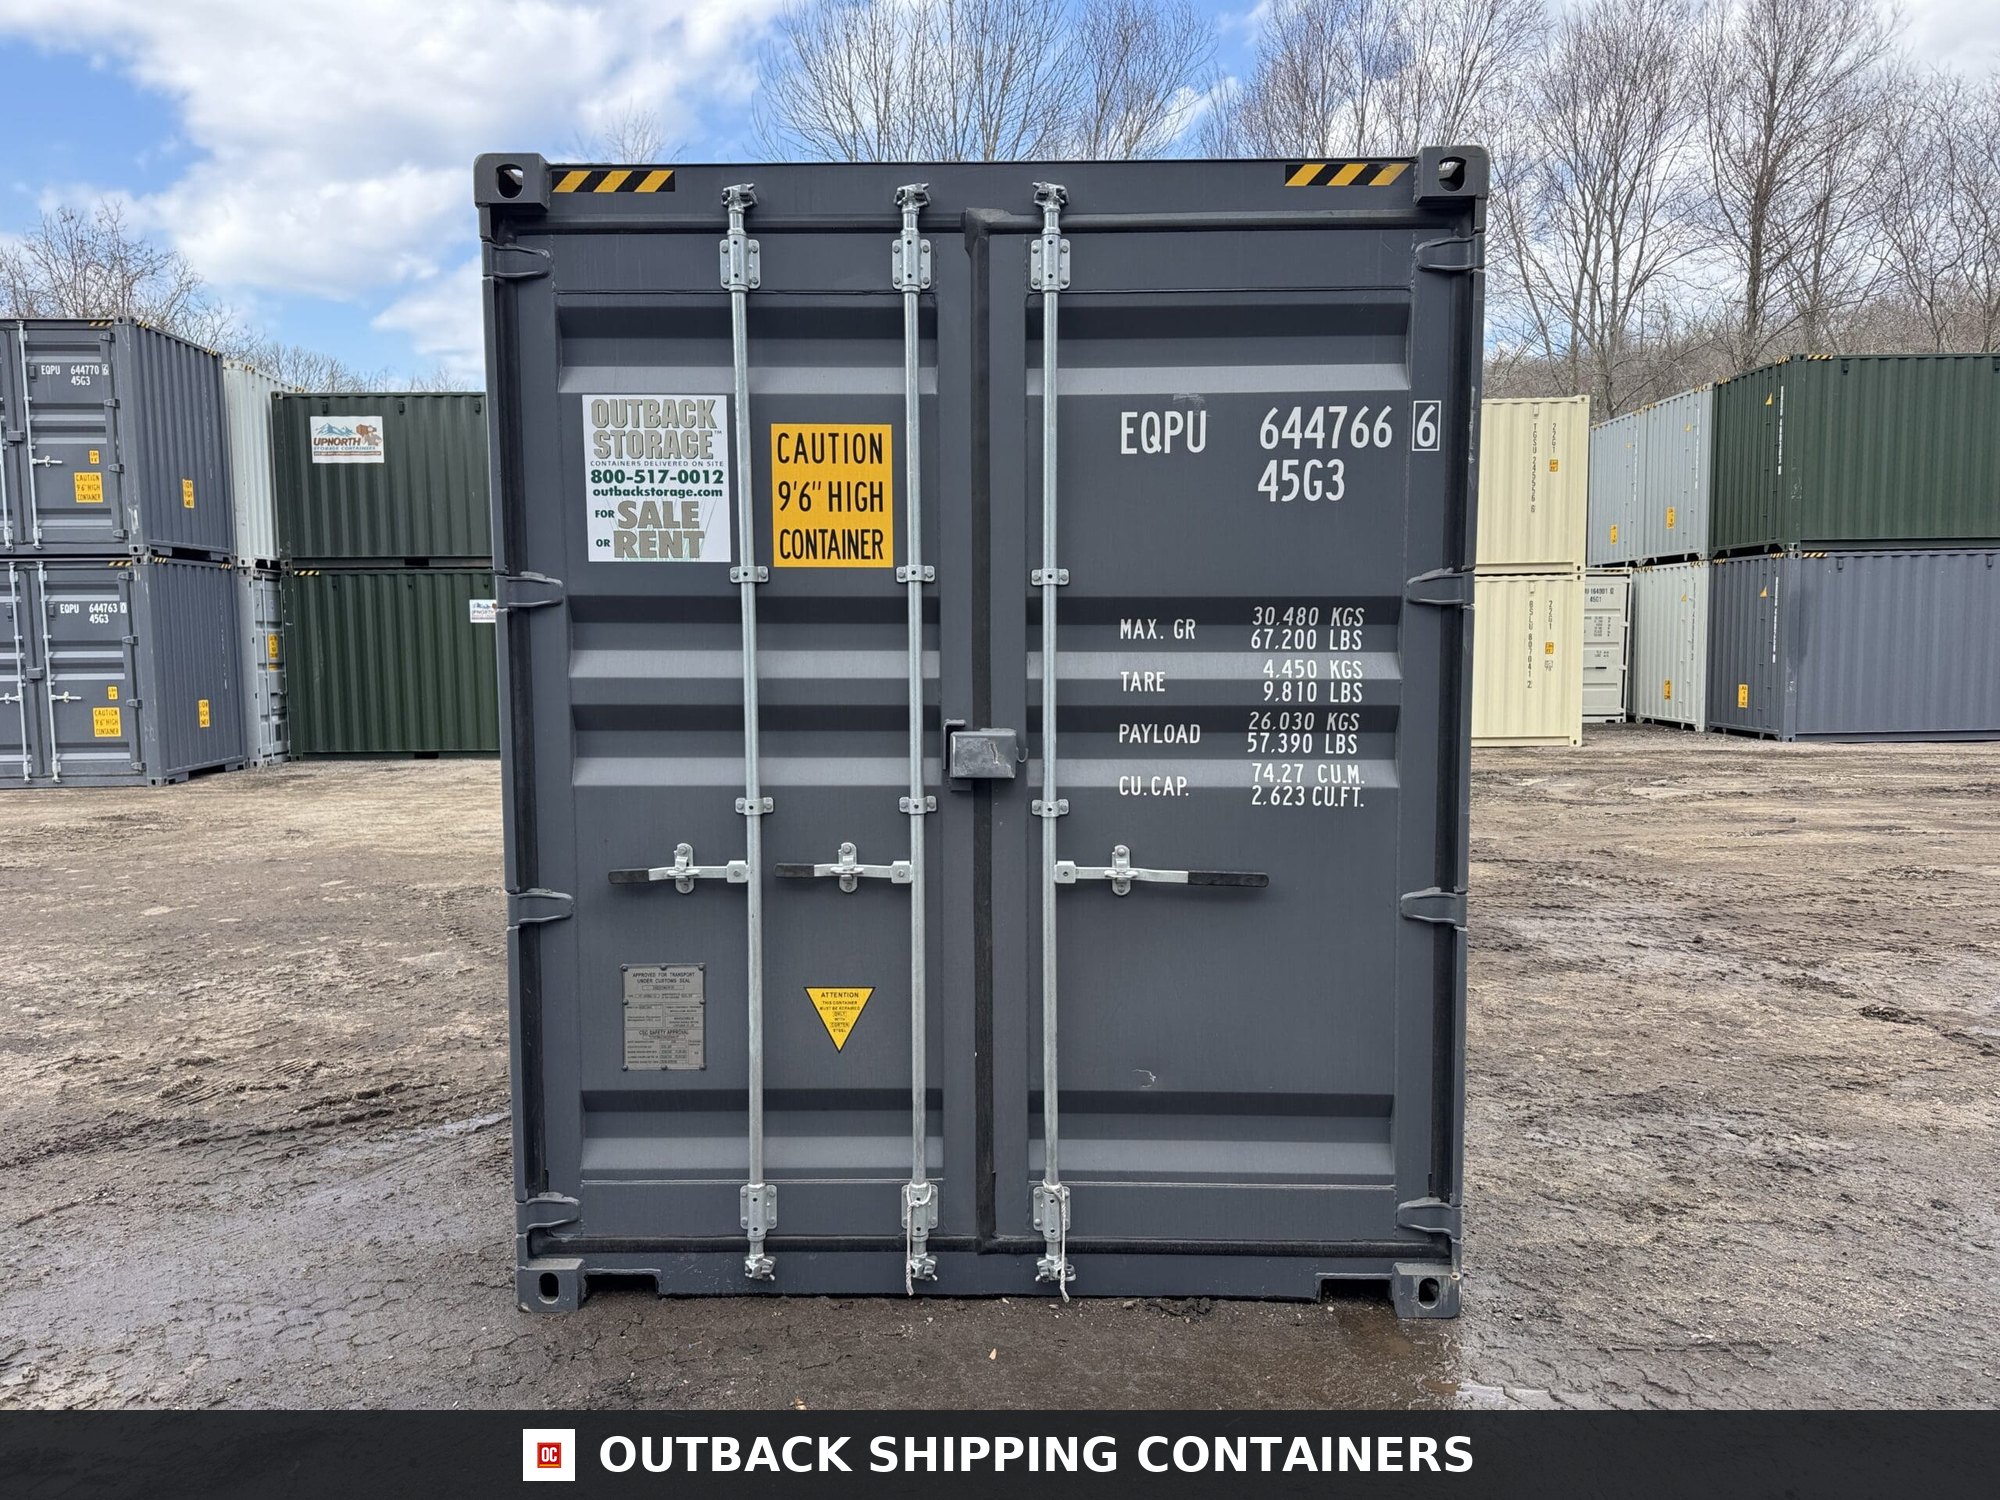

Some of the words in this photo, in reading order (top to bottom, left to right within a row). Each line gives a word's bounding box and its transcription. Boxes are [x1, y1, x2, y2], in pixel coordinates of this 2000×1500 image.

[41, 364, 61, 375] EQPU
[70, 364, 100, 375] 644770
[70, 376, 91, 386] 45G3
[591, 399, 717, 429] OUTBACK
[1121, 410, 1207, 454] EQPU
[1259, 405, 1393, 449] 644766
[1415, 402, 1438, 449] 6
[313, 437, 361, 446] UPNORTH
[592, 429, 714, 459] STORAGE
[777, 432, 883, 464] CAUTION
[590, 469, 724, 484] 800-517-0012
[1257, 458, 1345, 502] 45G3
[593, 485, 723, 498] outbackstorage.com
[828, 481, 884, 512] HIGH
[595, 510, 615, 518] FOR
[617, 500, 700, 529] SALE
[595, 539, 611, 547] OR
[613, 530, 705, 558] RENT
[780, 528, 884, 560] CONTAINER
[60, 603, 79, 614] EQPU
[89, 603, 118, 614] 644763
[89, 614, 109, 624] 45G3
[1330, 607, 1365, 627] KGS
[1120, 618, 1165, 640] MAX.
[1173, 618, 1196, 640] GR
[1329, 629, 1363, 650] LBS
[1329, 660, 1363, 680] KGS
[1120, 671, 1166, 692] TARE
[1329, 681, 1364, 703] LBS
[1527, 680, 1532, 688] 2
[1326, 712, 1360, 731] KGS
[1119, 723, 1201, 744] PAYLOAD
[1325, 733, 1358, 754] LBS
[1251, 762, 1304, 783] 74.27
[1119, 776, 1190, 797] CU.CAP.
